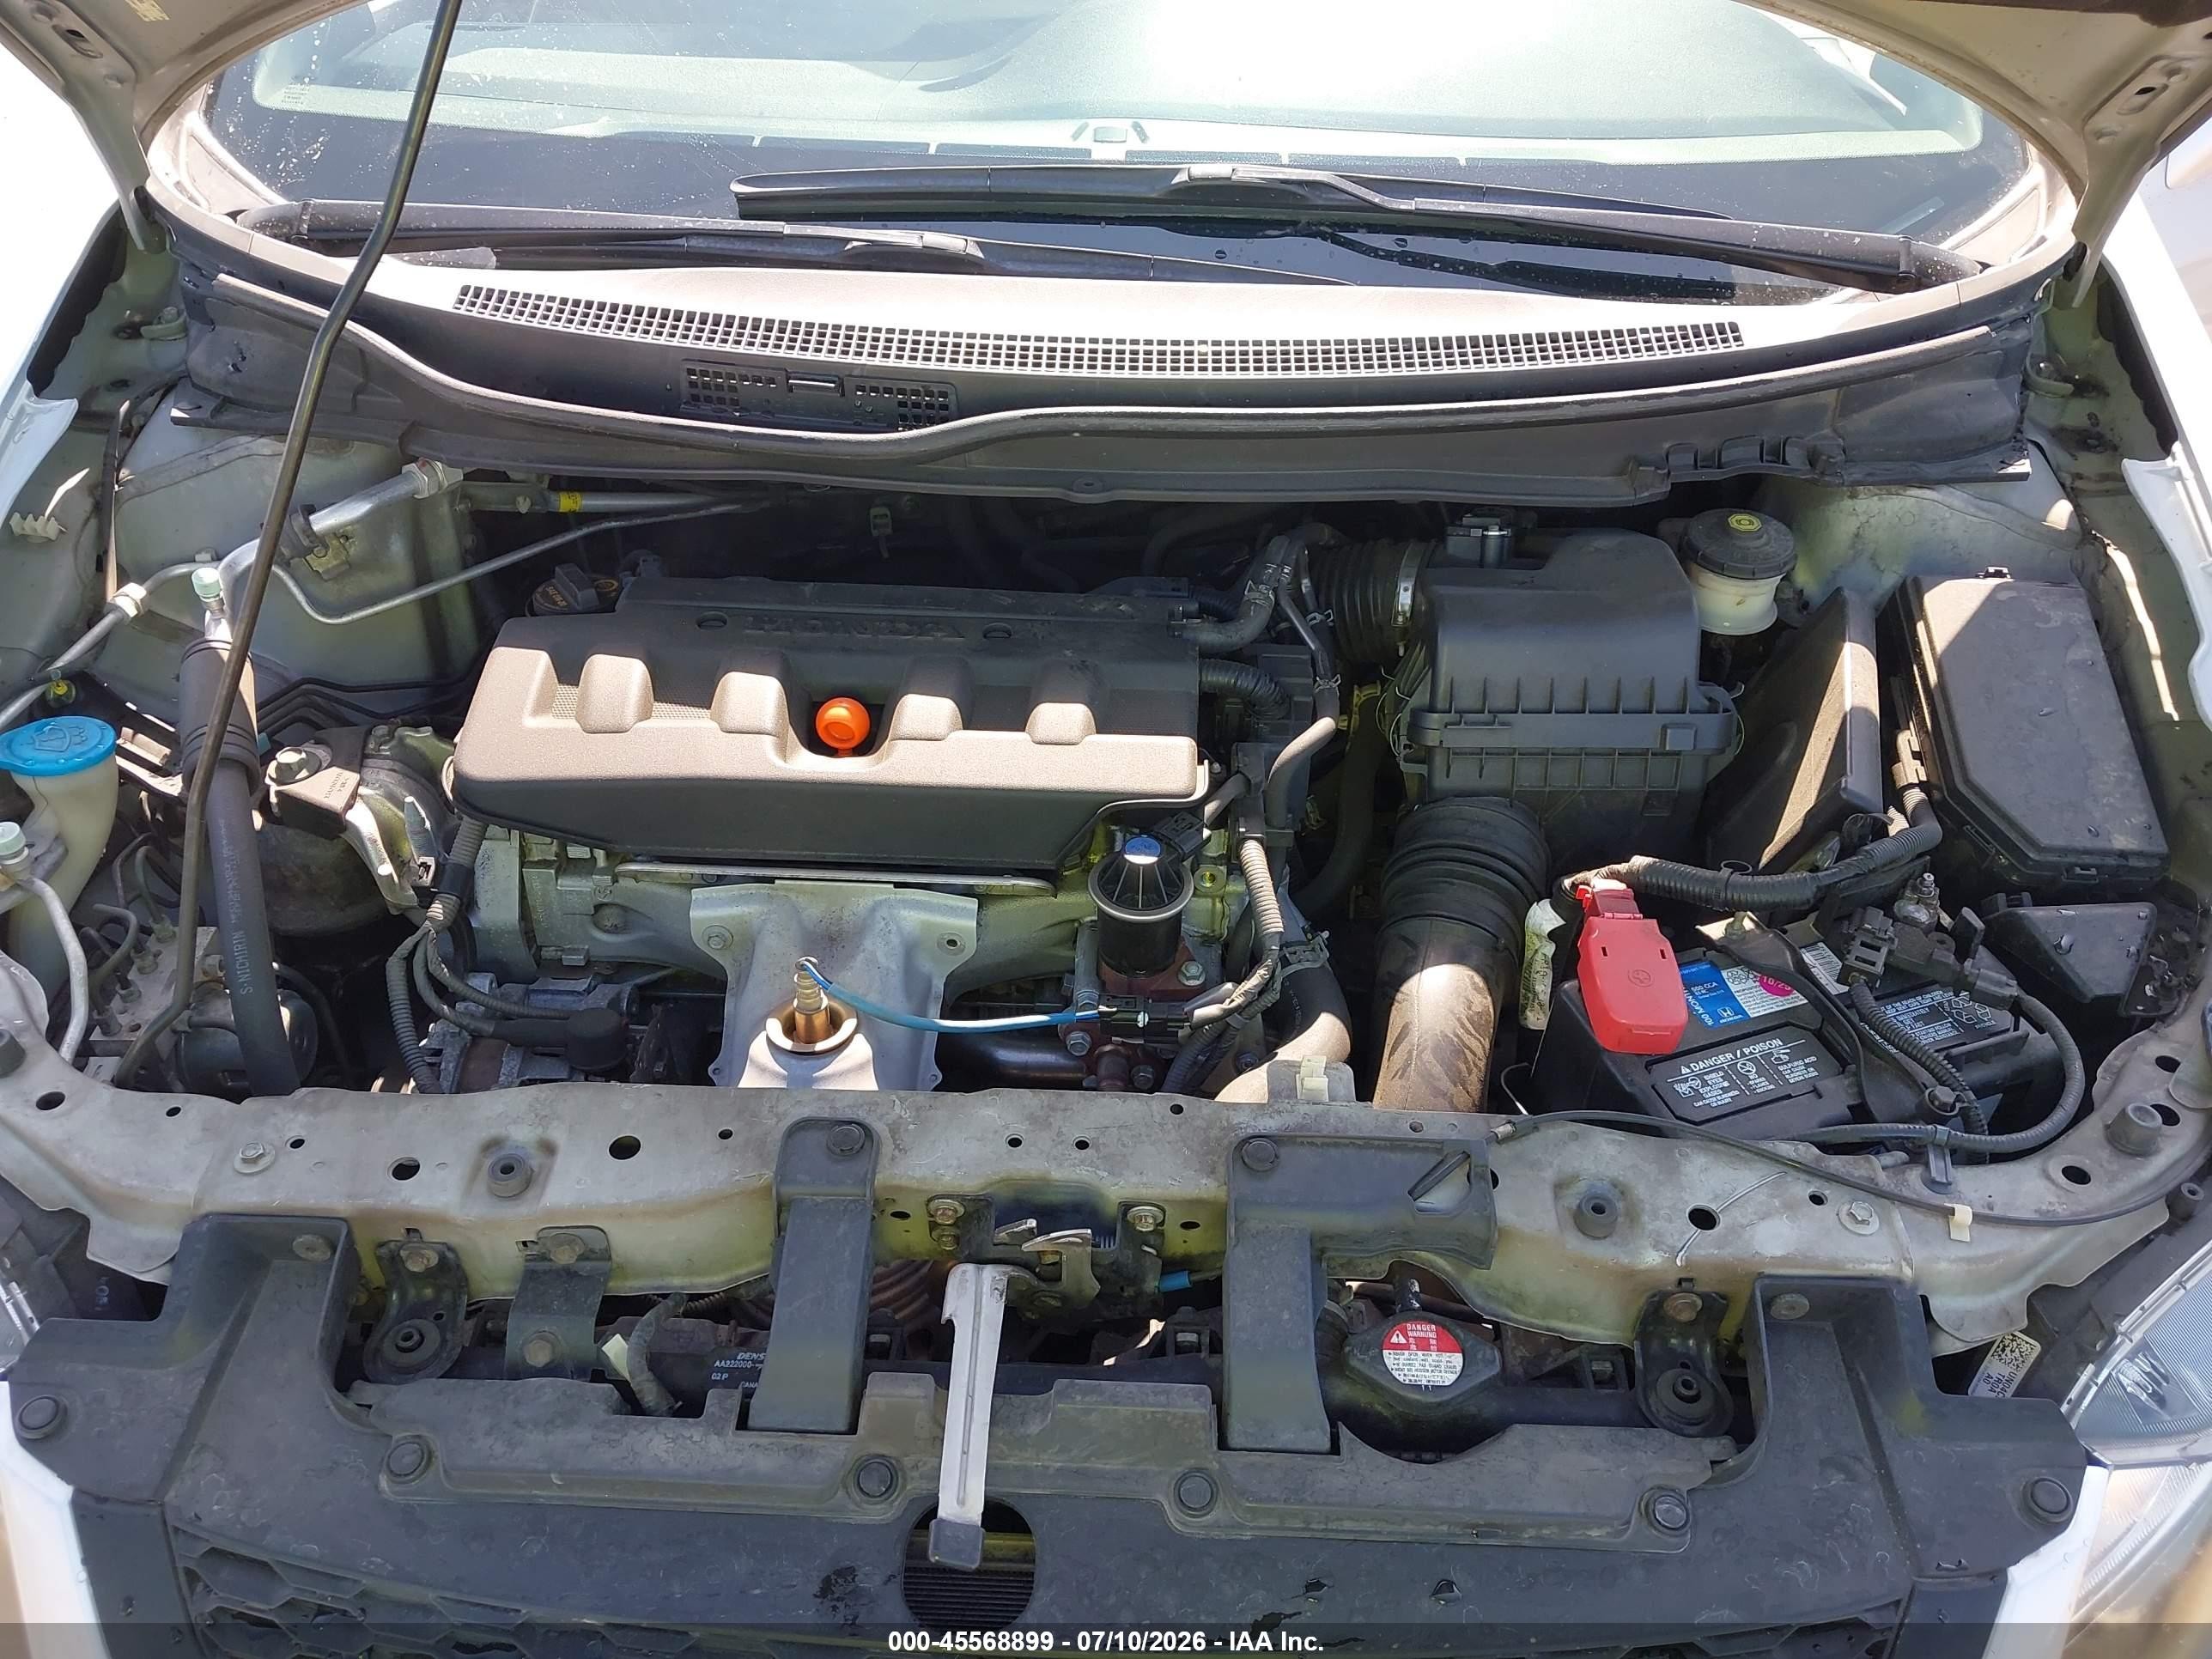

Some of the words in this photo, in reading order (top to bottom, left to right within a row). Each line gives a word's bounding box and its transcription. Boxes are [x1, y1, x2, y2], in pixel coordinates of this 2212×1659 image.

[1700, 1013, 1715, 1027] 100
[1689, 1052, 1735, 1072] DANGER
[1736, 1048, 1742, 1059] /
[1743, 1037, 1784, 1055] POISON
[1996, 1371, 2019, 1398] UN04C
